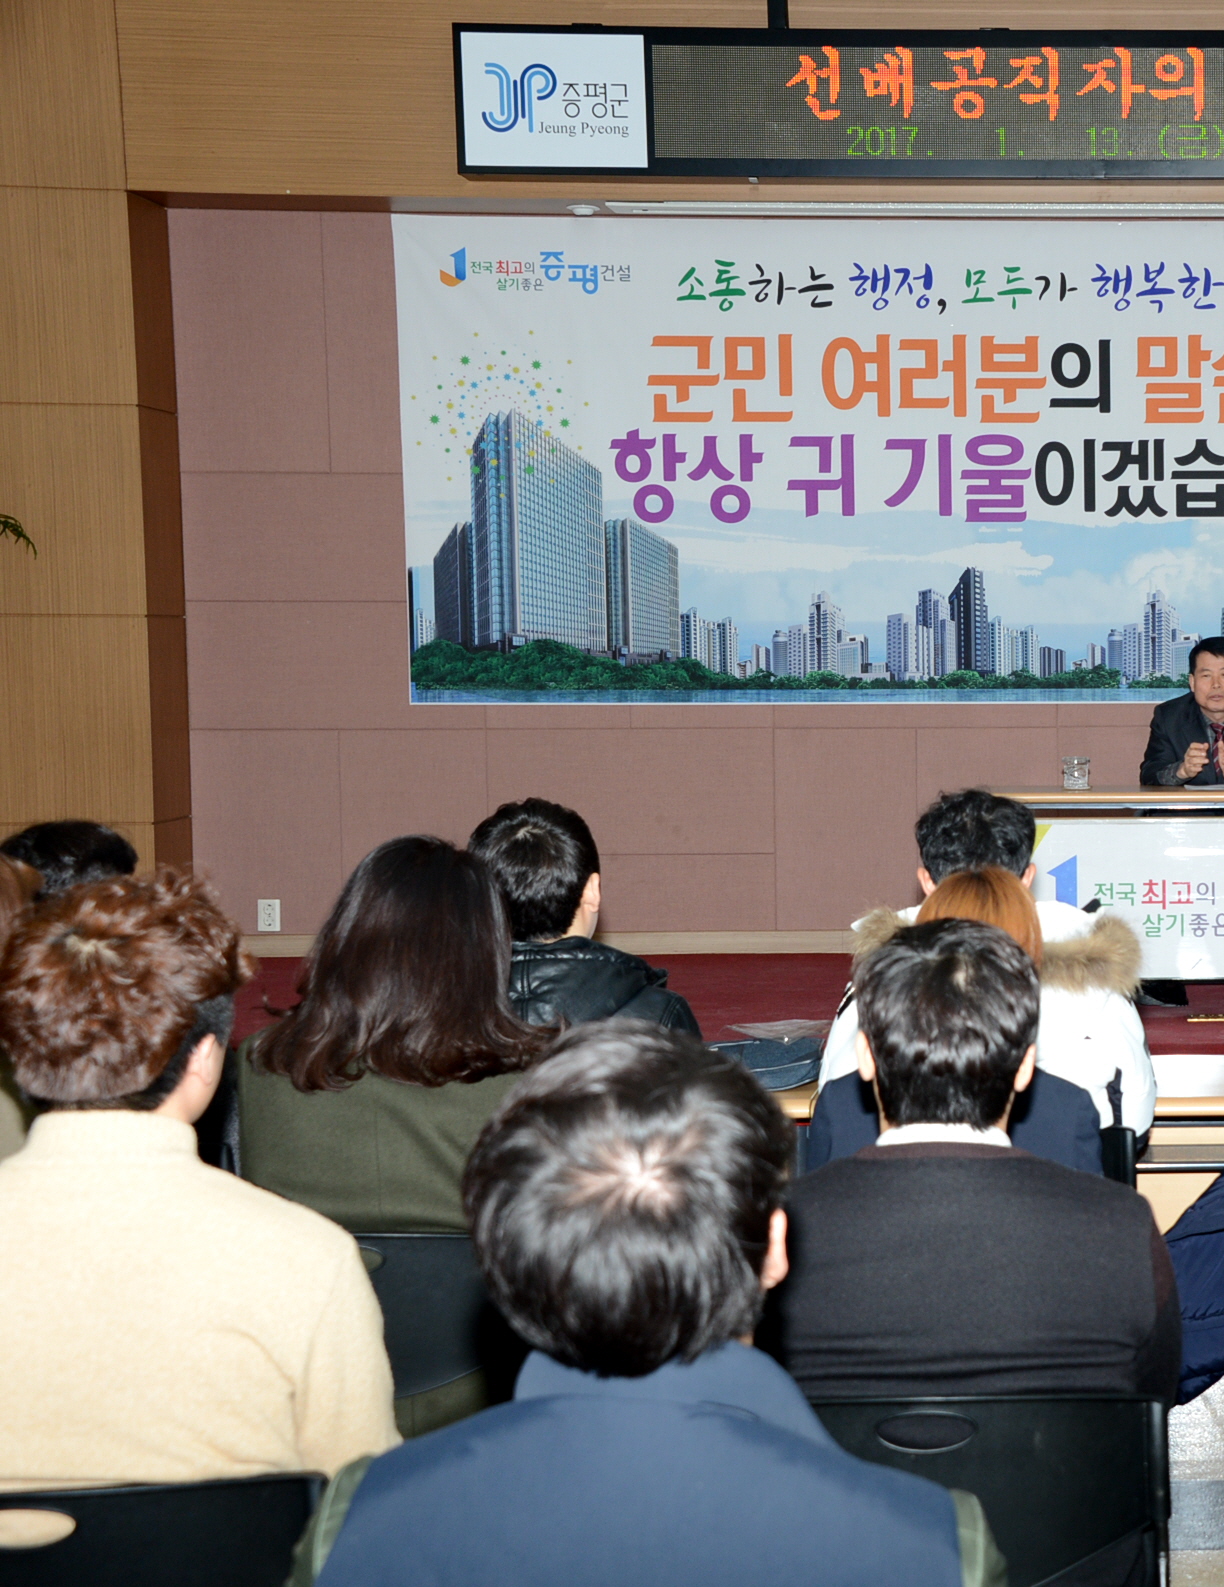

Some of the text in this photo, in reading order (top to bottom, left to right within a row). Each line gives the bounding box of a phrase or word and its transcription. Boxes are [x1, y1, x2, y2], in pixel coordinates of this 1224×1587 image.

[562, 83, 629, 119] 증평군
[538, 121, 630, 138] Jeung Pyeong
[846, 126, 934, 157] 2017.
[677, 260, 834, 312] 소통하는
[849, 263, 948, 315] 행정,
[962, 267, 1077, 309] 모두가
[1091, 262, 1224, 313] 행복한
[648, 334, 793, 422] 군민
[821, 334, 1111, 423] 여러분의
[609, 428, 764, 524] 항상
[787, 434, 856, 518] 귀
[1093, 882, 1137, 906] 전국
